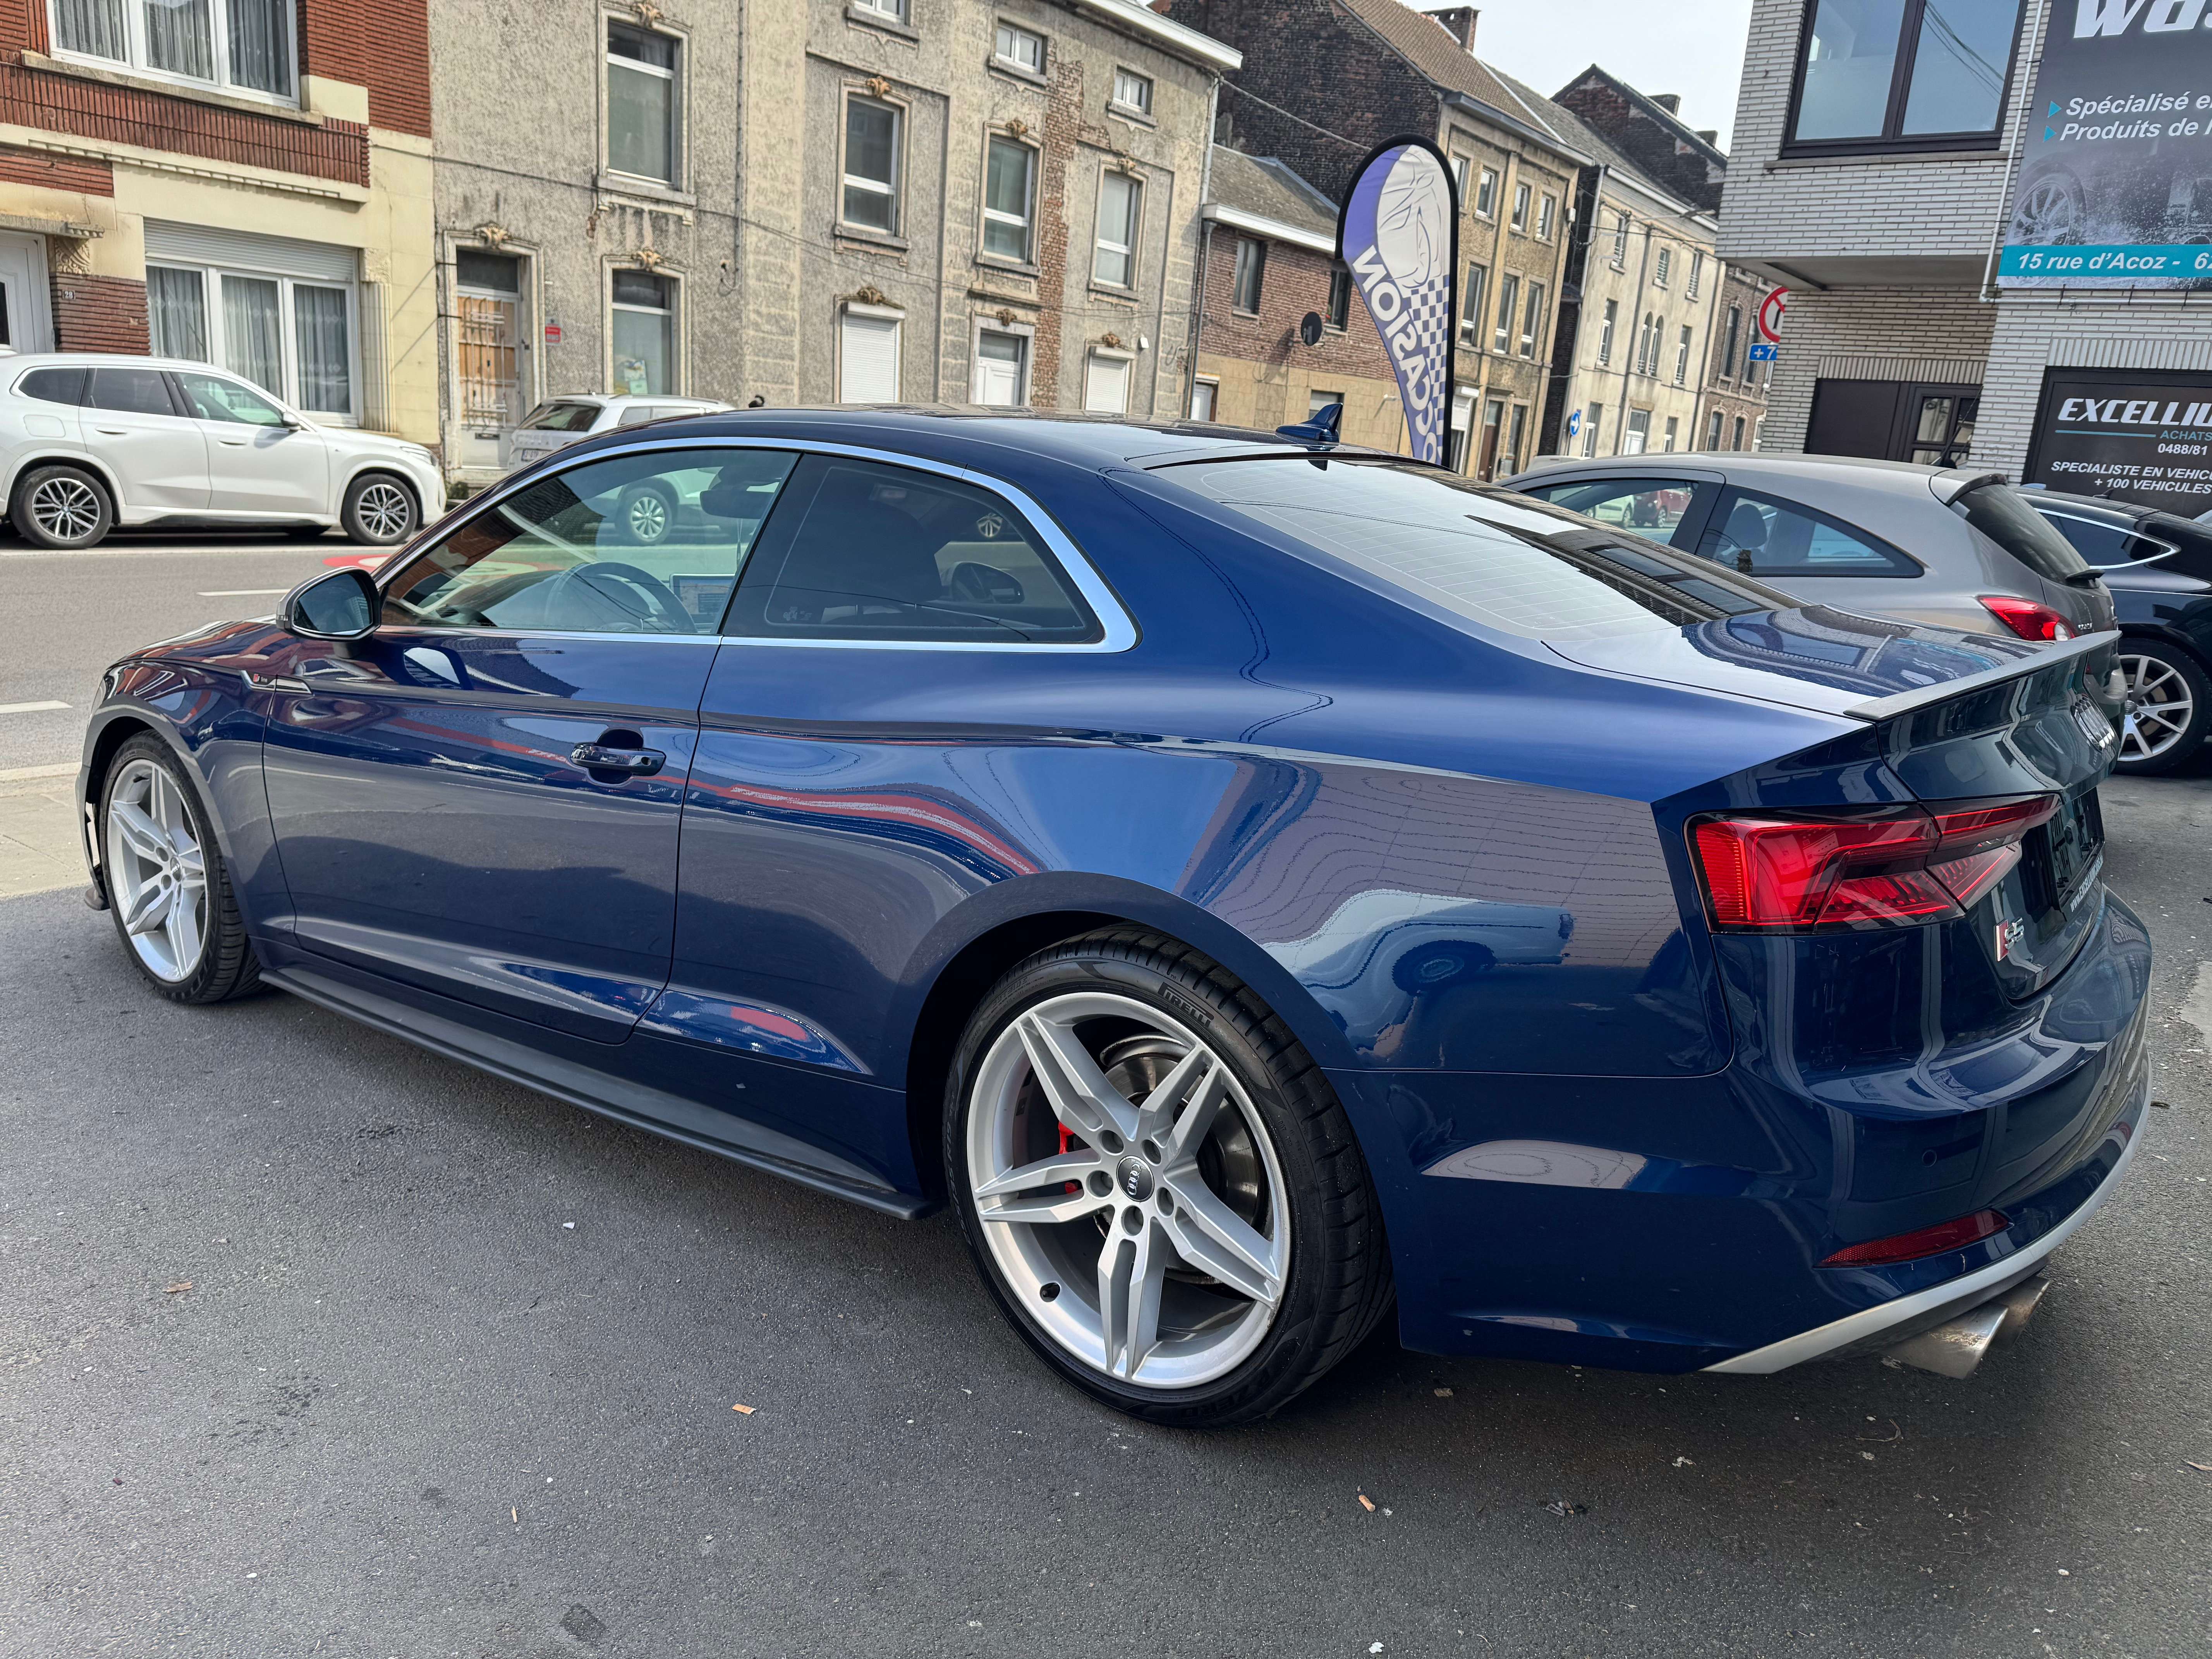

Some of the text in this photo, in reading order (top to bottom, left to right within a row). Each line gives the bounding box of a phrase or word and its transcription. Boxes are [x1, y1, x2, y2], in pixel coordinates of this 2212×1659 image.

[2066, 91, 2212, 119] Spécialisé e
[2060, 120, 2162, 141] Produits
[2169, 118, 2198, 136] de
[2019, 252, 2043, 269] 15
[2046, 256, 2084, 269] rue
[2157, 443, 2207, 456] 0488/81
[2051, 461, 2142, 476] SPECIALISTE
[2142, 467, 2164, 477] EN
[2107, 478, 2129, 489] 100
[2133, 480, 2212, 495] VEHICULES
[1158, 982, 1214, 1028] PIRELLI
